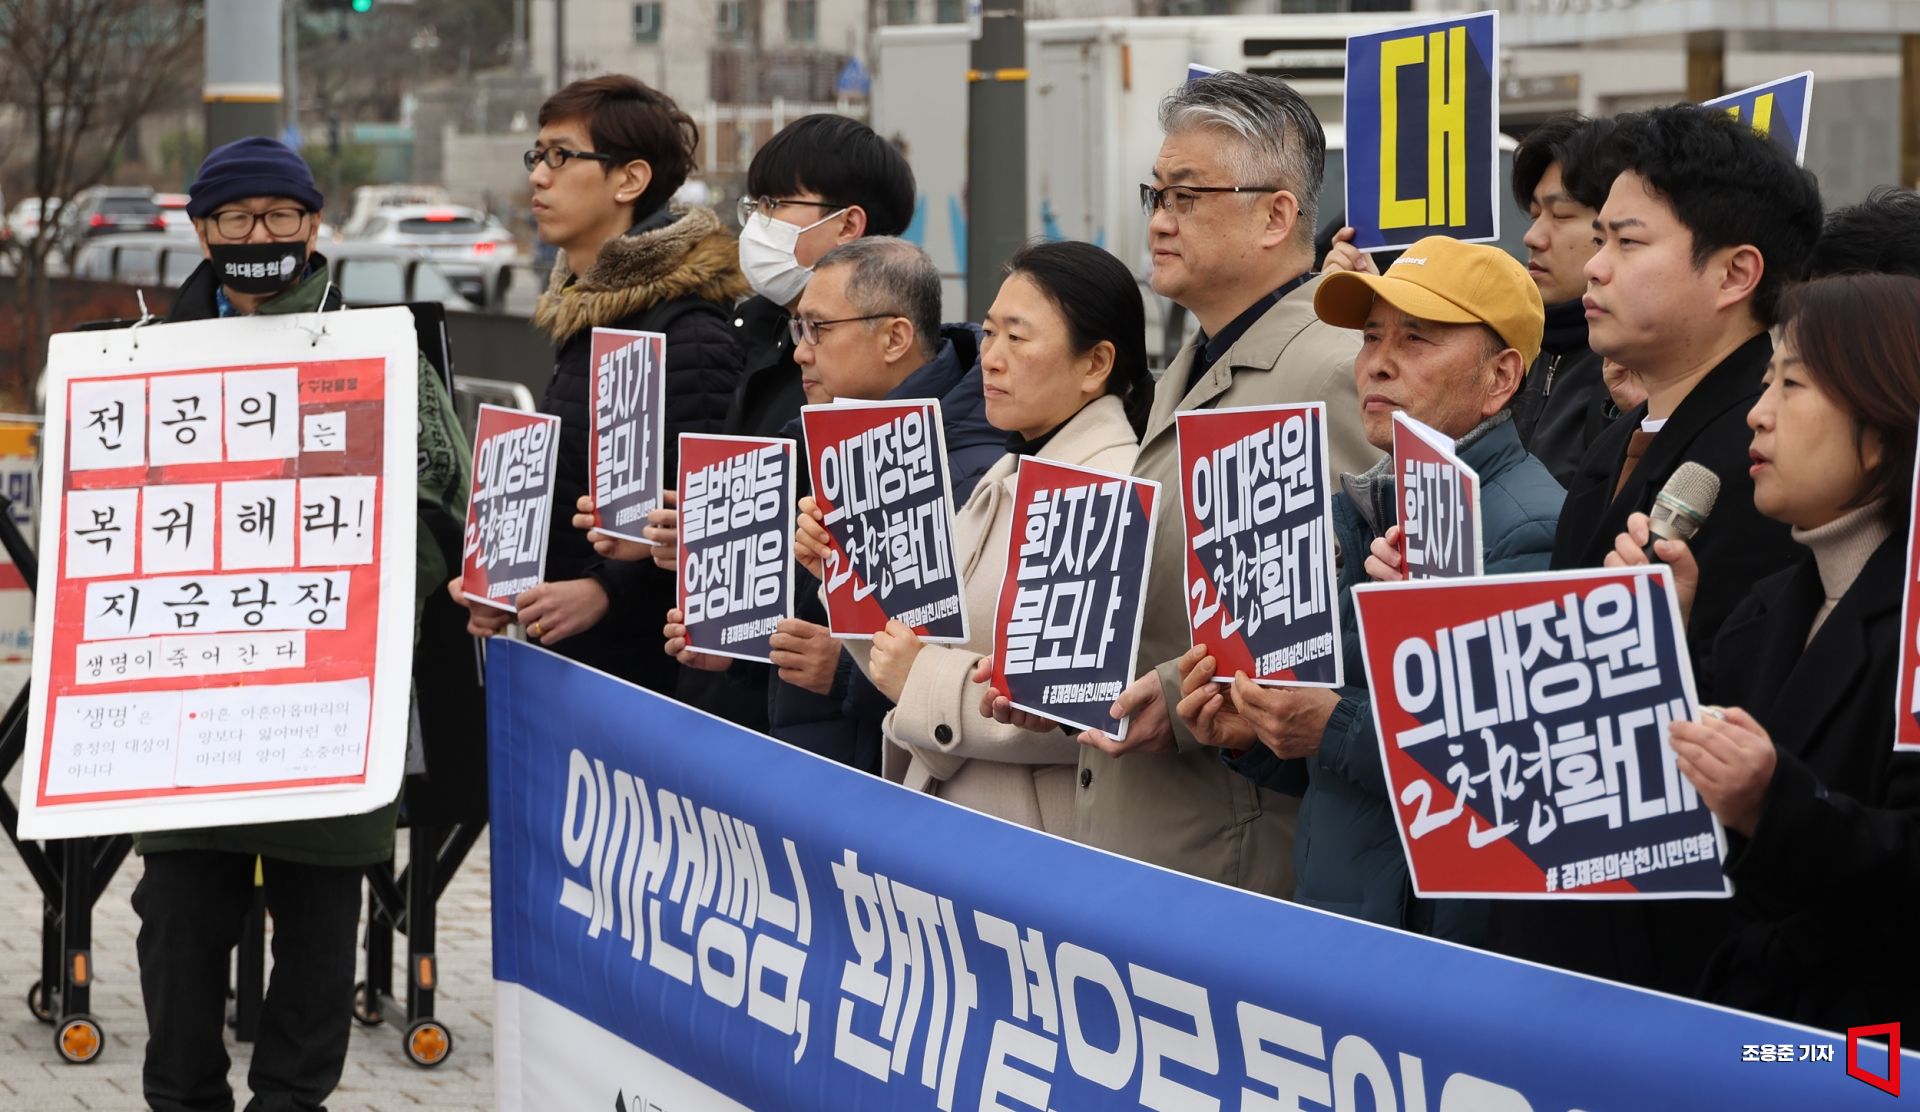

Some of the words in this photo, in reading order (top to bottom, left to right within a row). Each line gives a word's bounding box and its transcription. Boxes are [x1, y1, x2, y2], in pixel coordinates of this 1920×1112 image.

[1378, 26, 1467, 231] 대
[224, 261, 280, 278] 의대증원
[596, 336, 652, 432] 환자가
[473, 420, 551, 502] 의대정원
[596, 415, 652, 509] 볼모냐
[683, 442, 784, 544] 불법행동
[820, 405, 936, 527] 의대정원
[1191, 408, 1316, 551] 의대정원
[74, 495, 364, 556] 복귀해라!
[1016, 479, 1132, 582] 환자가
[1403, 458, 1464, 574] 환자가
[99, 577, 342, 633] 지금당장
[683, 529, 784, 627] 엄정대응
[1004, 576, 1124, 676] 볼모냐
[1393, 574, 1661, 750] 의대정원
[560, 748, 812, 1064] 의사선생님,
[831, 848, 978, 1112] 환자
